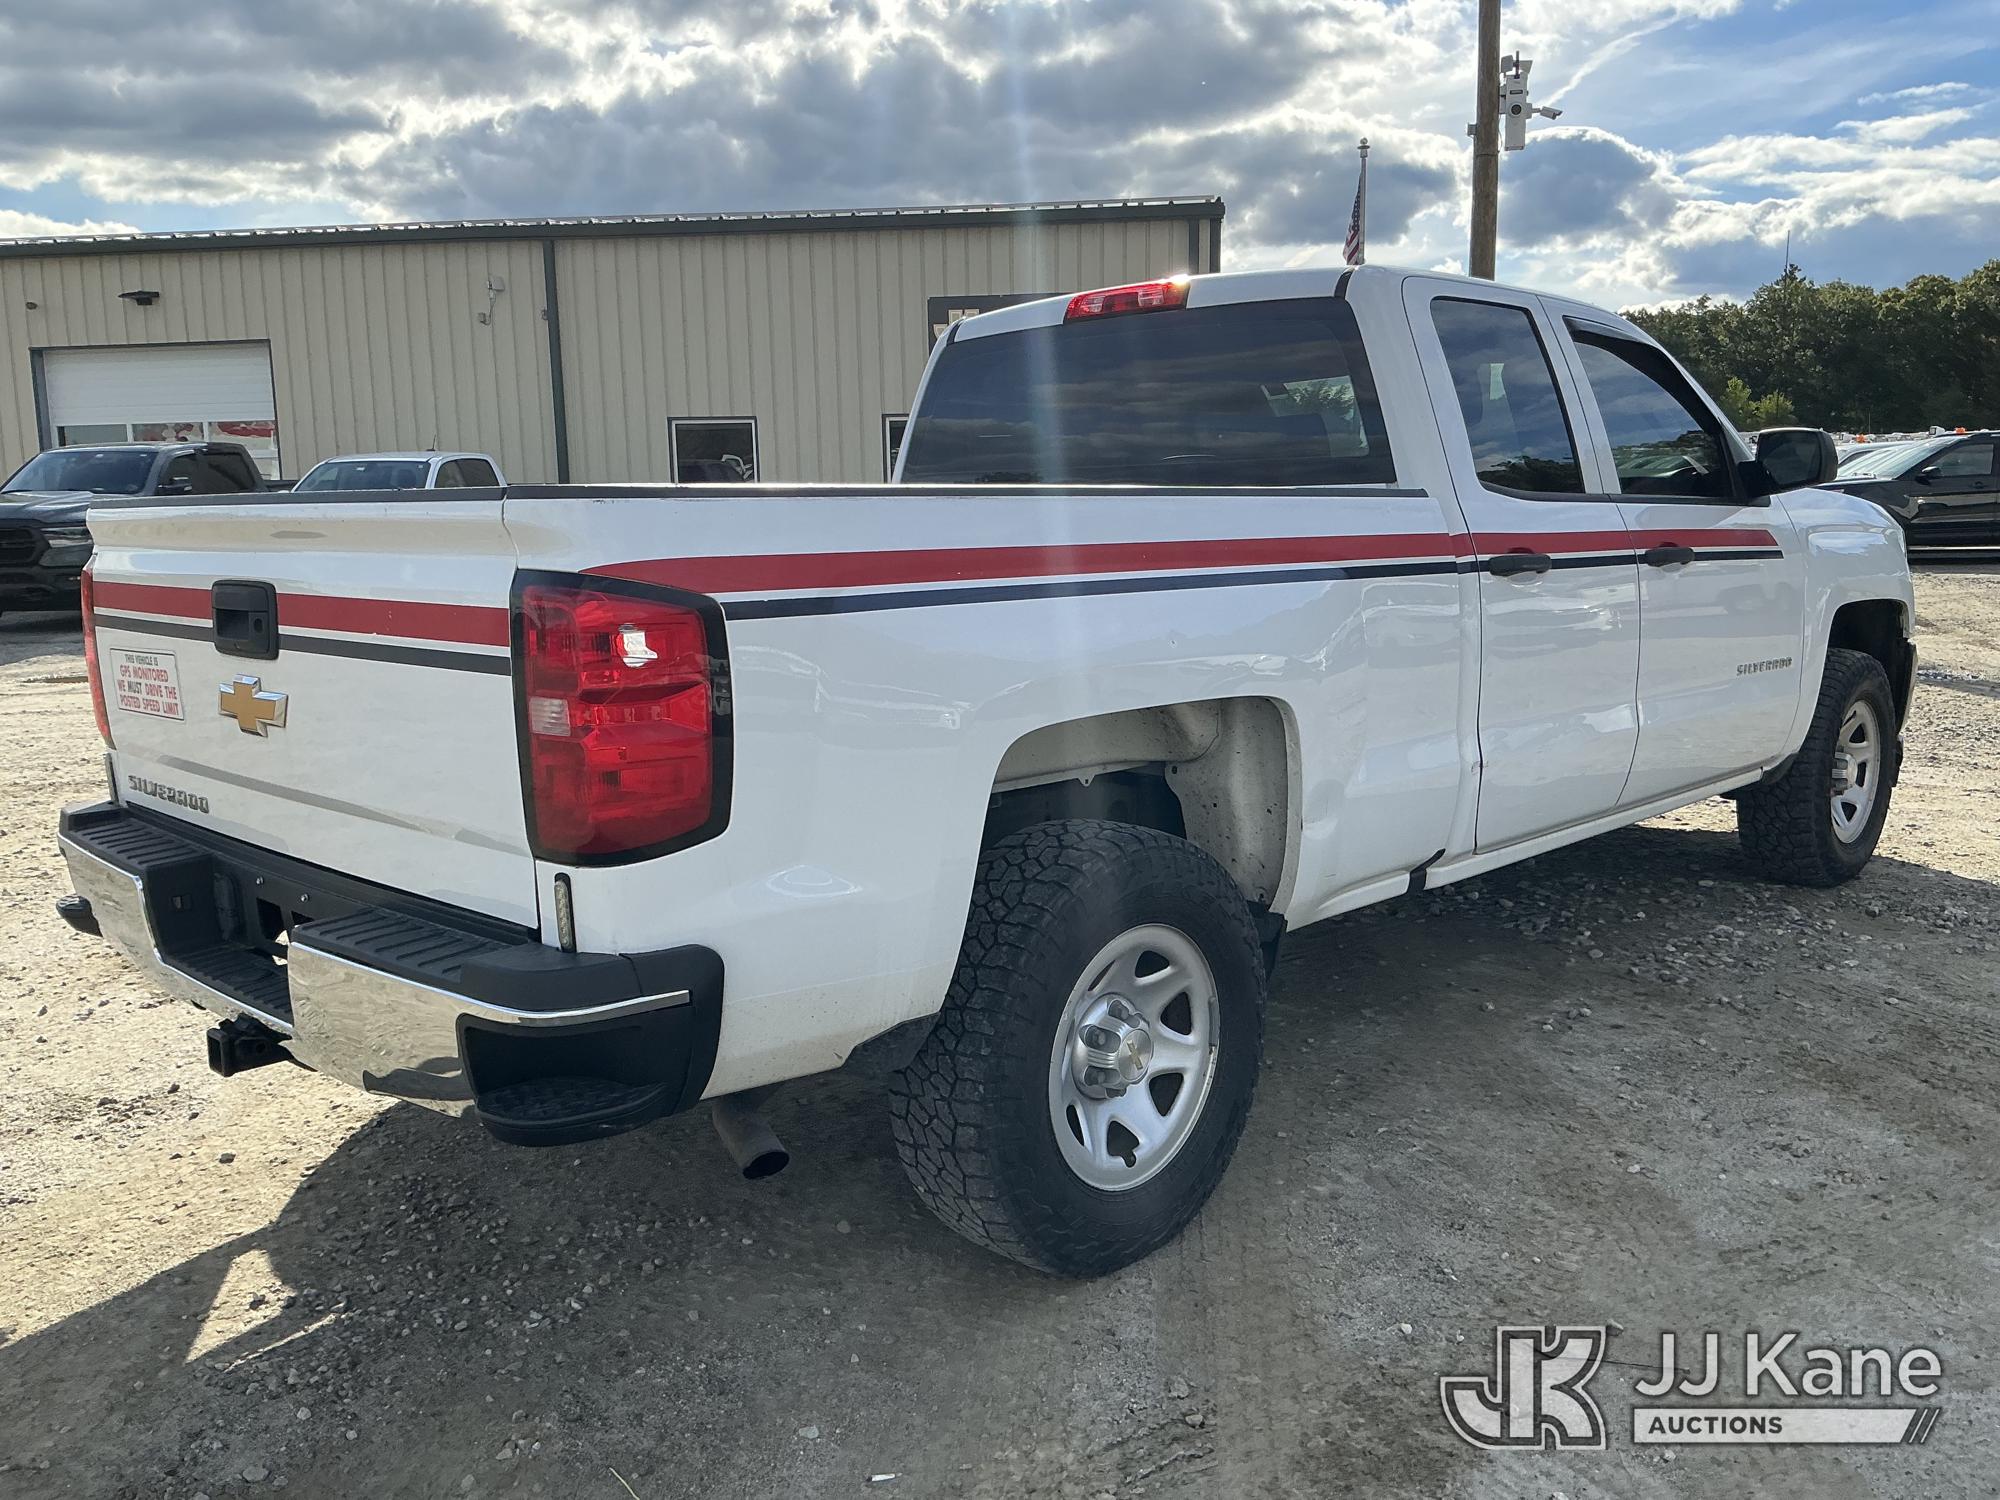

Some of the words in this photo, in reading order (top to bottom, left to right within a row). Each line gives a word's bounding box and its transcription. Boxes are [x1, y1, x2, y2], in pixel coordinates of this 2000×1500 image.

[125, 654, 135, 663] THIS
[135, 655, 153, 666] VEHICLE
[153, 657, 159, 666] IS
[1736, 657, 1793, 676] SILVERADO
[120, 664, 132, 678] GPS
[133, 666, 169, 682] MONITORED
[117, 679, 126, 692] WE
[127, 680, 142, 694] MUST
[145, 683, 163, 697] DRIVE
[164, 686, 177, 699] THE
[120, 694, 141, 709] POSTED
[142, 697, 160, 712] SPEED
[162, 701, 179, 715] LIMIT
[128, 775, 209, 814] SILVERADO
